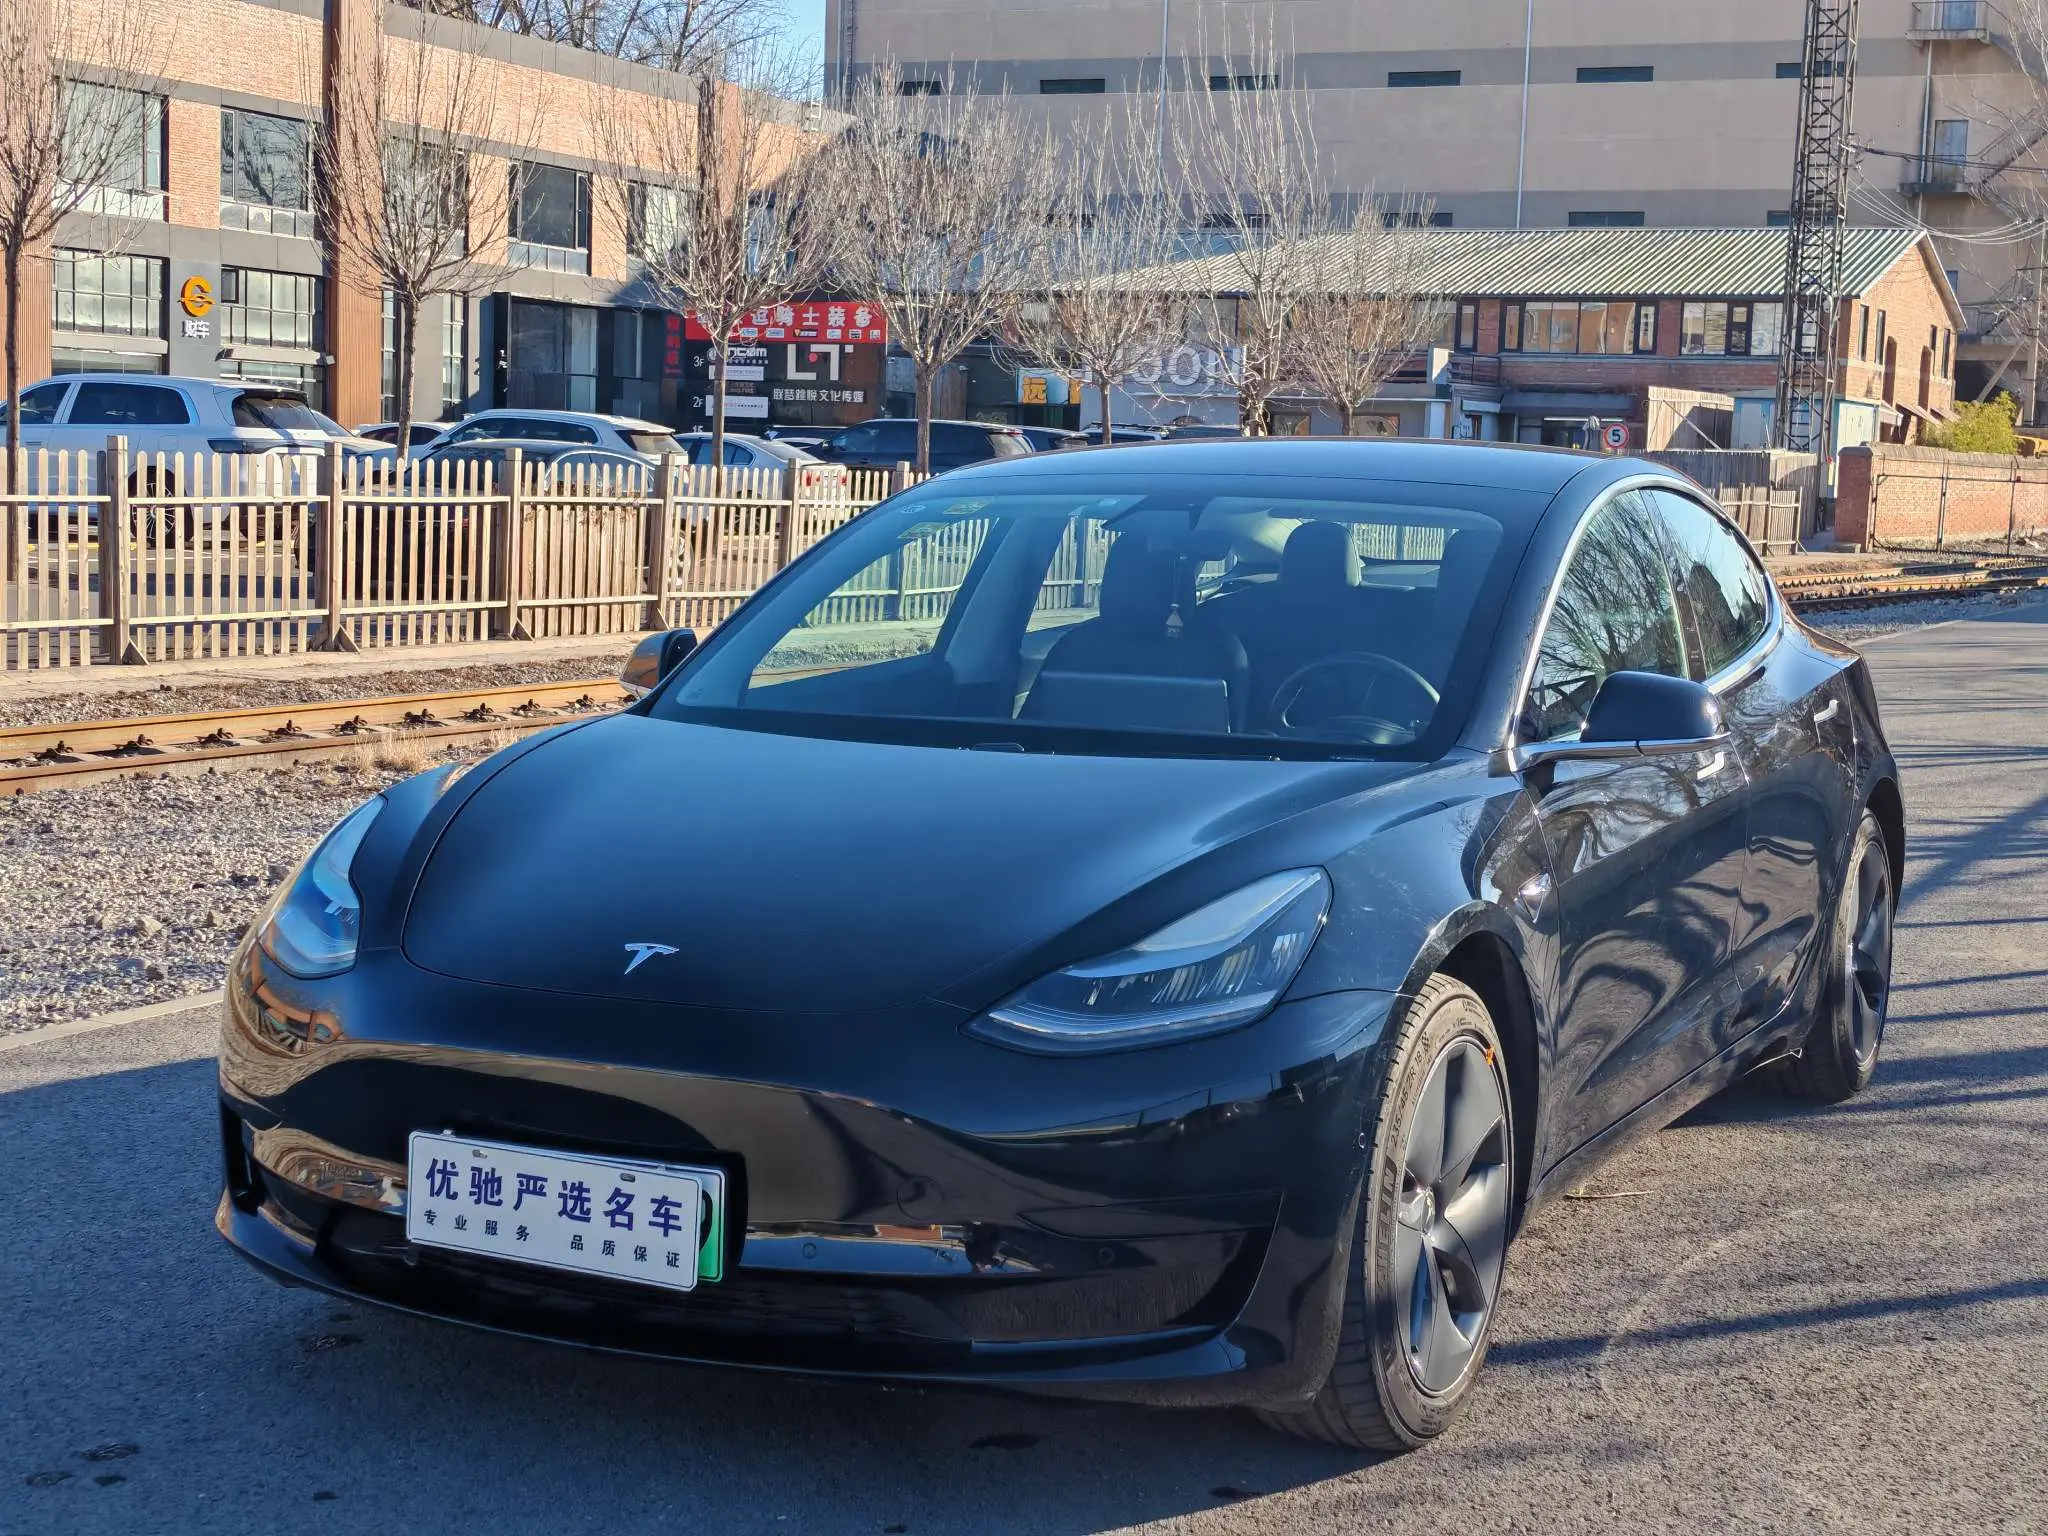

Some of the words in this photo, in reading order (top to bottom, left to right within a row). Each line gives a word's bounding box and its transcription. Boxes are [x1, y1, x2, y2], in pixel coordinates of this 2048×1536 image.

[693, 355, 705, 367] 3F
[692, 396, 704, 408] 2F
[1612, 429, 1621, 443] 5
[425, 1158, 683, 1238] 优驰严选名车
[424, 1209, 530, 1242] 专业服务
[570, 1234, 680, 1268] 品质保证
